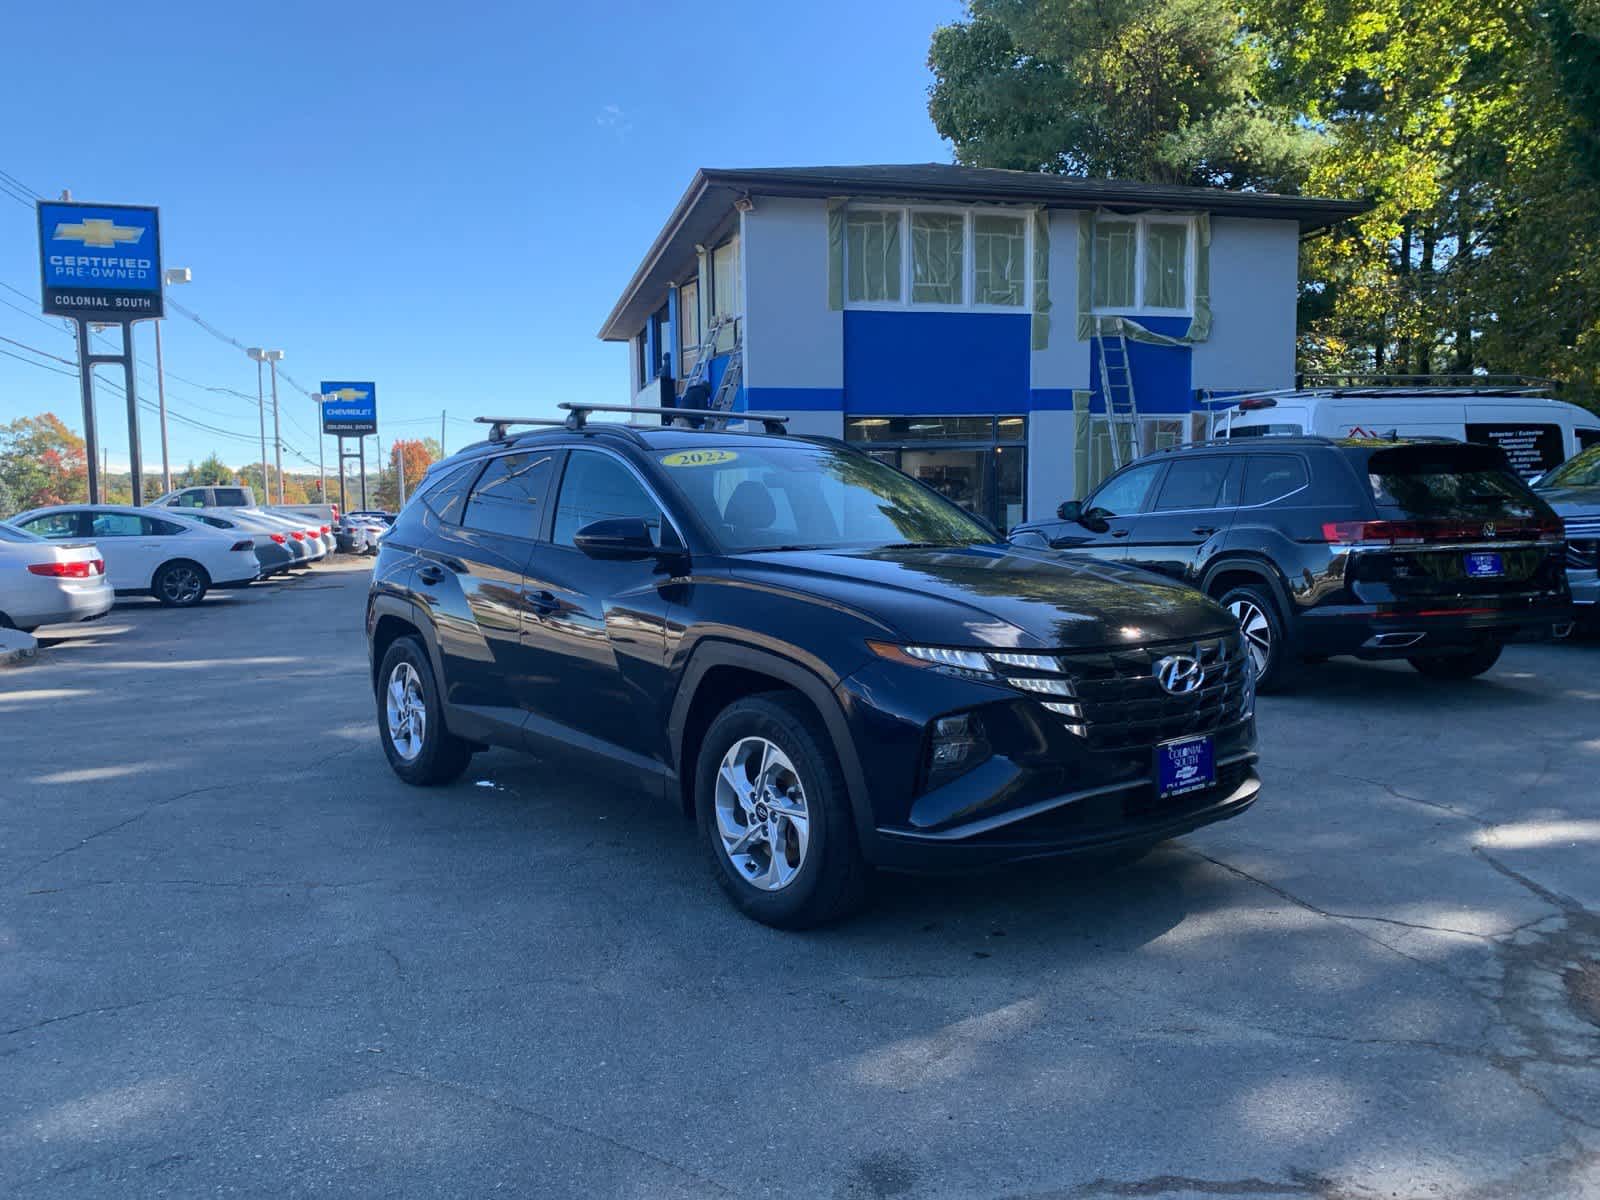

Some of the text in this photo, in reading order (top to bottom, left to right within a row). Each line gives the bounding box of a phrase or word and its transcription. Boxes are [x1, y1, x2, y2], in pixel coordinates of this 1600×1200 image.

[50, 255, 151, 269] CERTIFIED
[55, 266, 146, 279] PRE-OWNED
[55, 295, 151, 308] COLONIAL SOUTH
[326, 408, 371, 416] CHEVROLET
[680, 451, 727, 464] 2022
